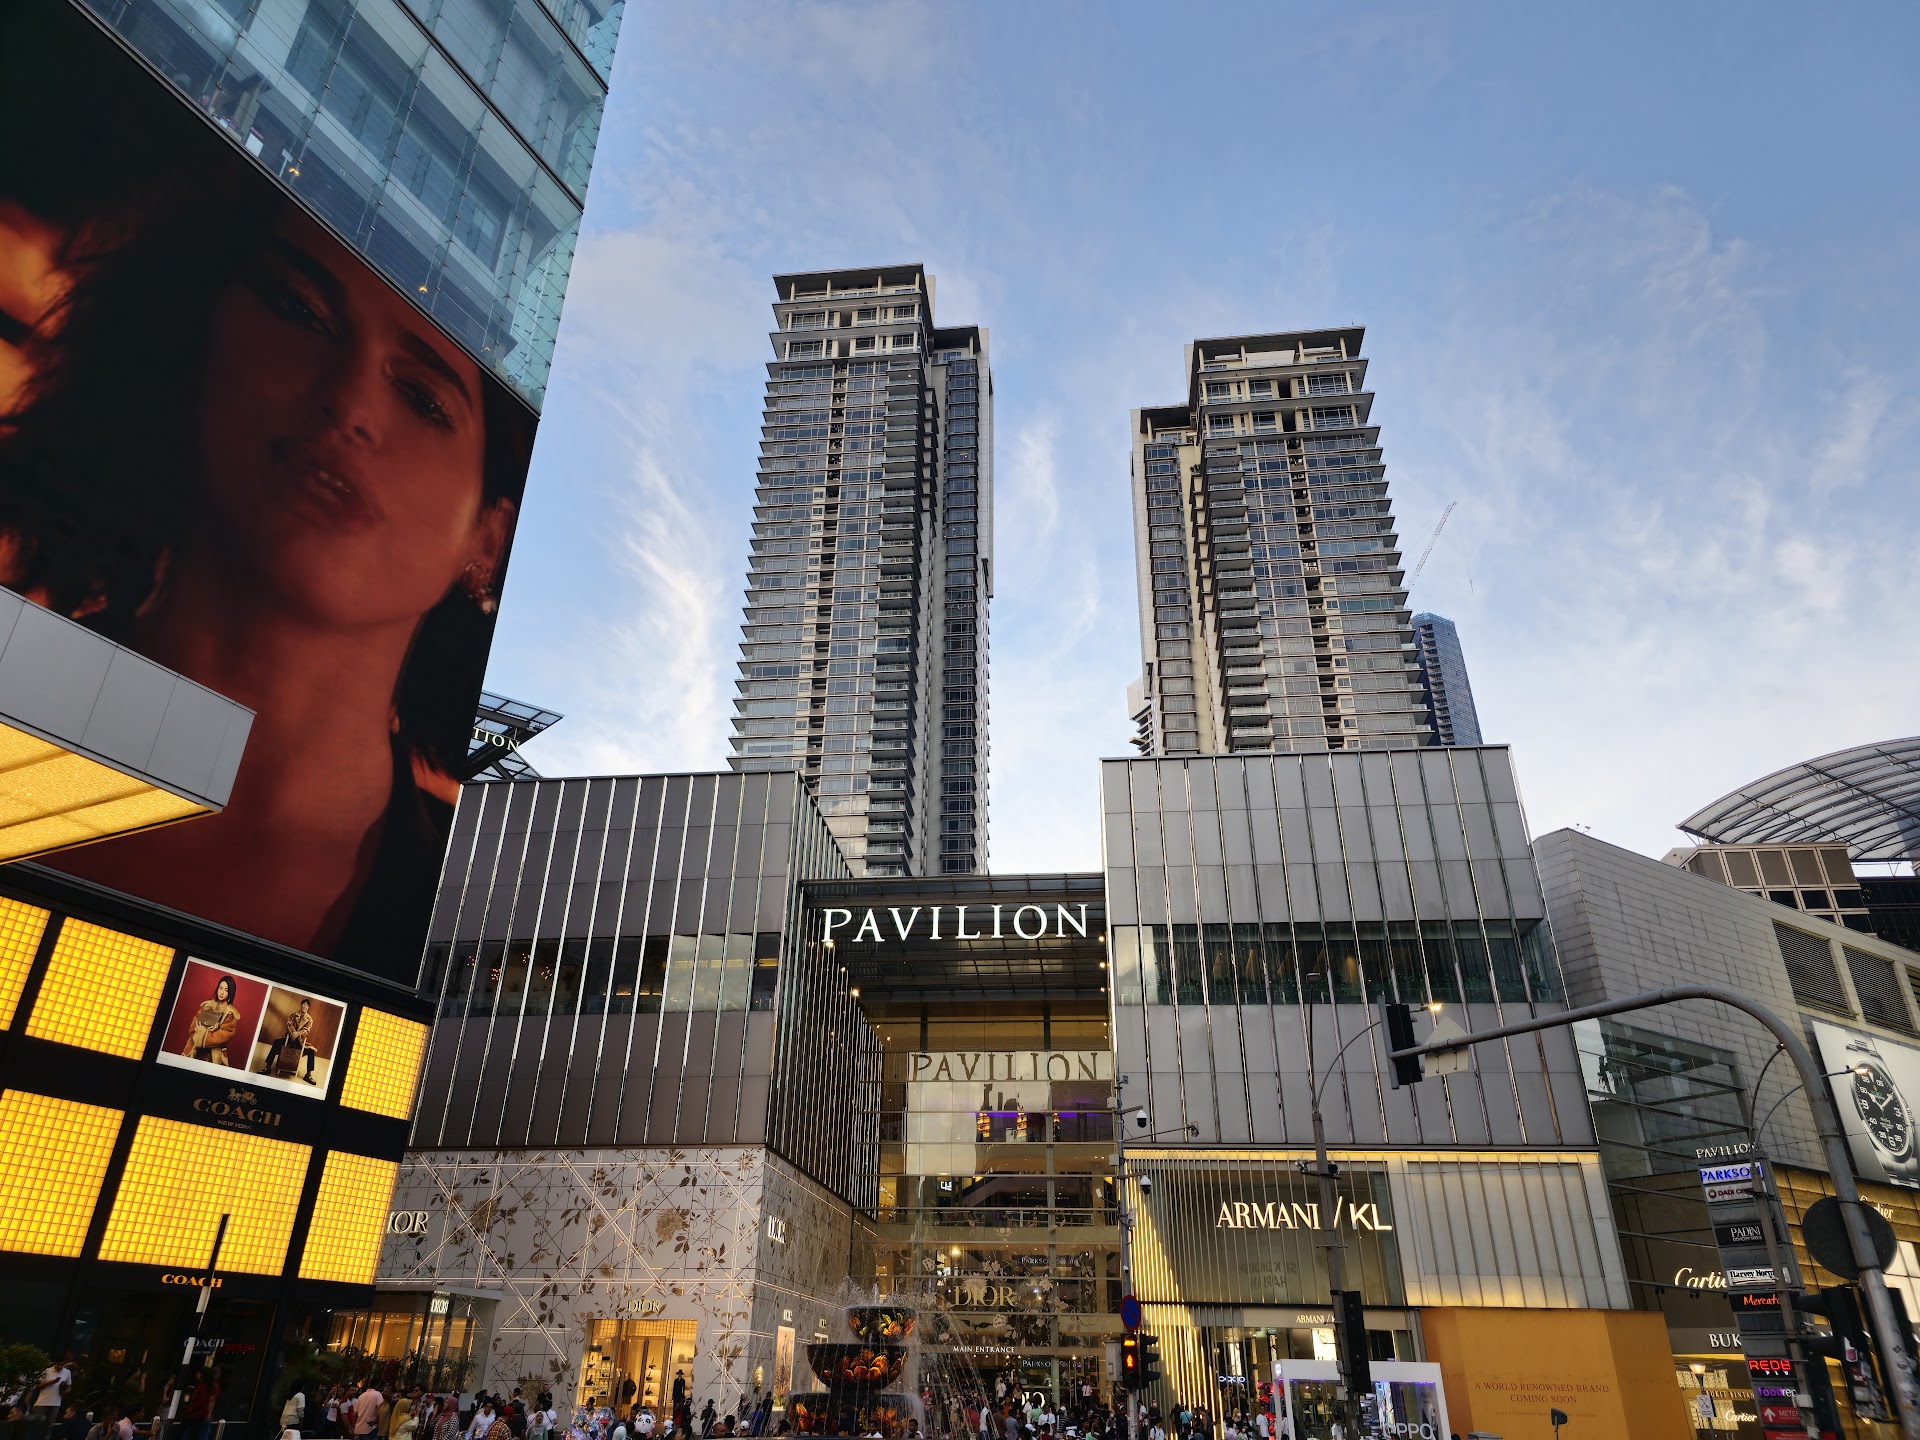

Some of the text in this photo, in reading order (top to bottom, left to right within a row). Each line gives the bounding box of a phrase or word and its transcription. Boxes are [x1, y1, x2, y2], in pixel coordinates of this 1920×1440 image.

[821, 903, 1089, 943] PAVILION
[911, 1052, 1098, 1081] PAVILION
[192, 1098, 283, 1127] COACH
[217, 1119, 252, 1130] NEW YORK
[1216, 1201, 1321, 1230] ARMANI
[1730, 1226, 1762, 1238] PADINI
[1730, 1270, 1755, 1278] Harvey
[953, 1285, 1017, 1307] DIOR
[627, 1299, 661, 1313] DIOR
[1295, 1314, 1325, 1324] ARMANI
[975, 1346, 1016, 1354] ENTRANCE
[1474, 1382, 1610, 1393] A WORLD RENOWNED BRAND
[1510, 1394, 1577, 1404] COMING SOON
[1725, 1410, 1758, 1422] Cartier
[1383, 1422, 1434, 1440] OPPO
